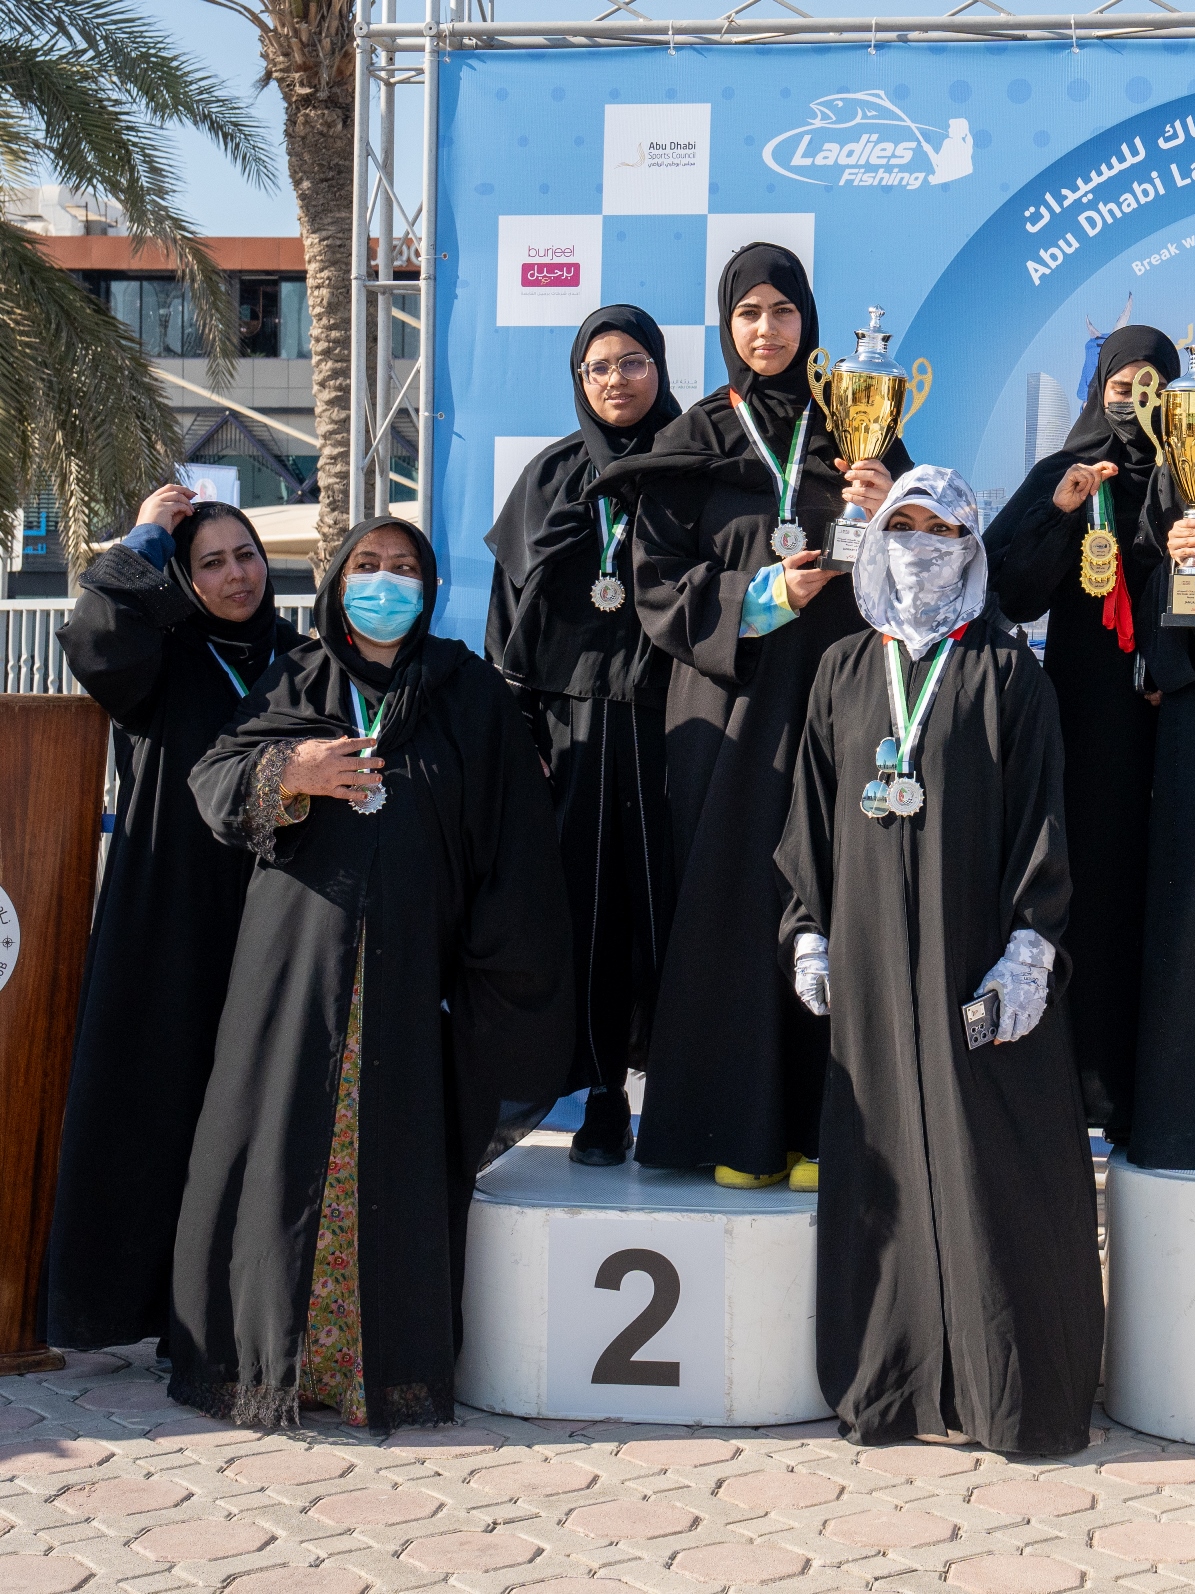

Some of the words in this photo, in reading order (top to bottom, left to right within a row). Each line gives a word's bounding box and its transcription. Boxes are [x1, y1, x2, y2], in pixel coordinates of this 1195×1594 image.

[648, 141, 667, 151] Abu
[669, 141, 697, 151] Dhabi
[648, 152, 670, 160] Sports
[671, 151, 696, 159] Council
[789, 133, 918, 166] Ladies
[838, 168, 926, 190] Fishing
[1023, 136, 1146, 234] للسيدات
[1025, 231, 1081, 286] Abu
[1077, 170, 1166, 238] Dhabi
[527, 244, 575, 261] burjeel
[1131, 242, 1180, 276] Break
[527, 264, 574, 280] برجيل
[591, 1248, 680, 1387] 2
